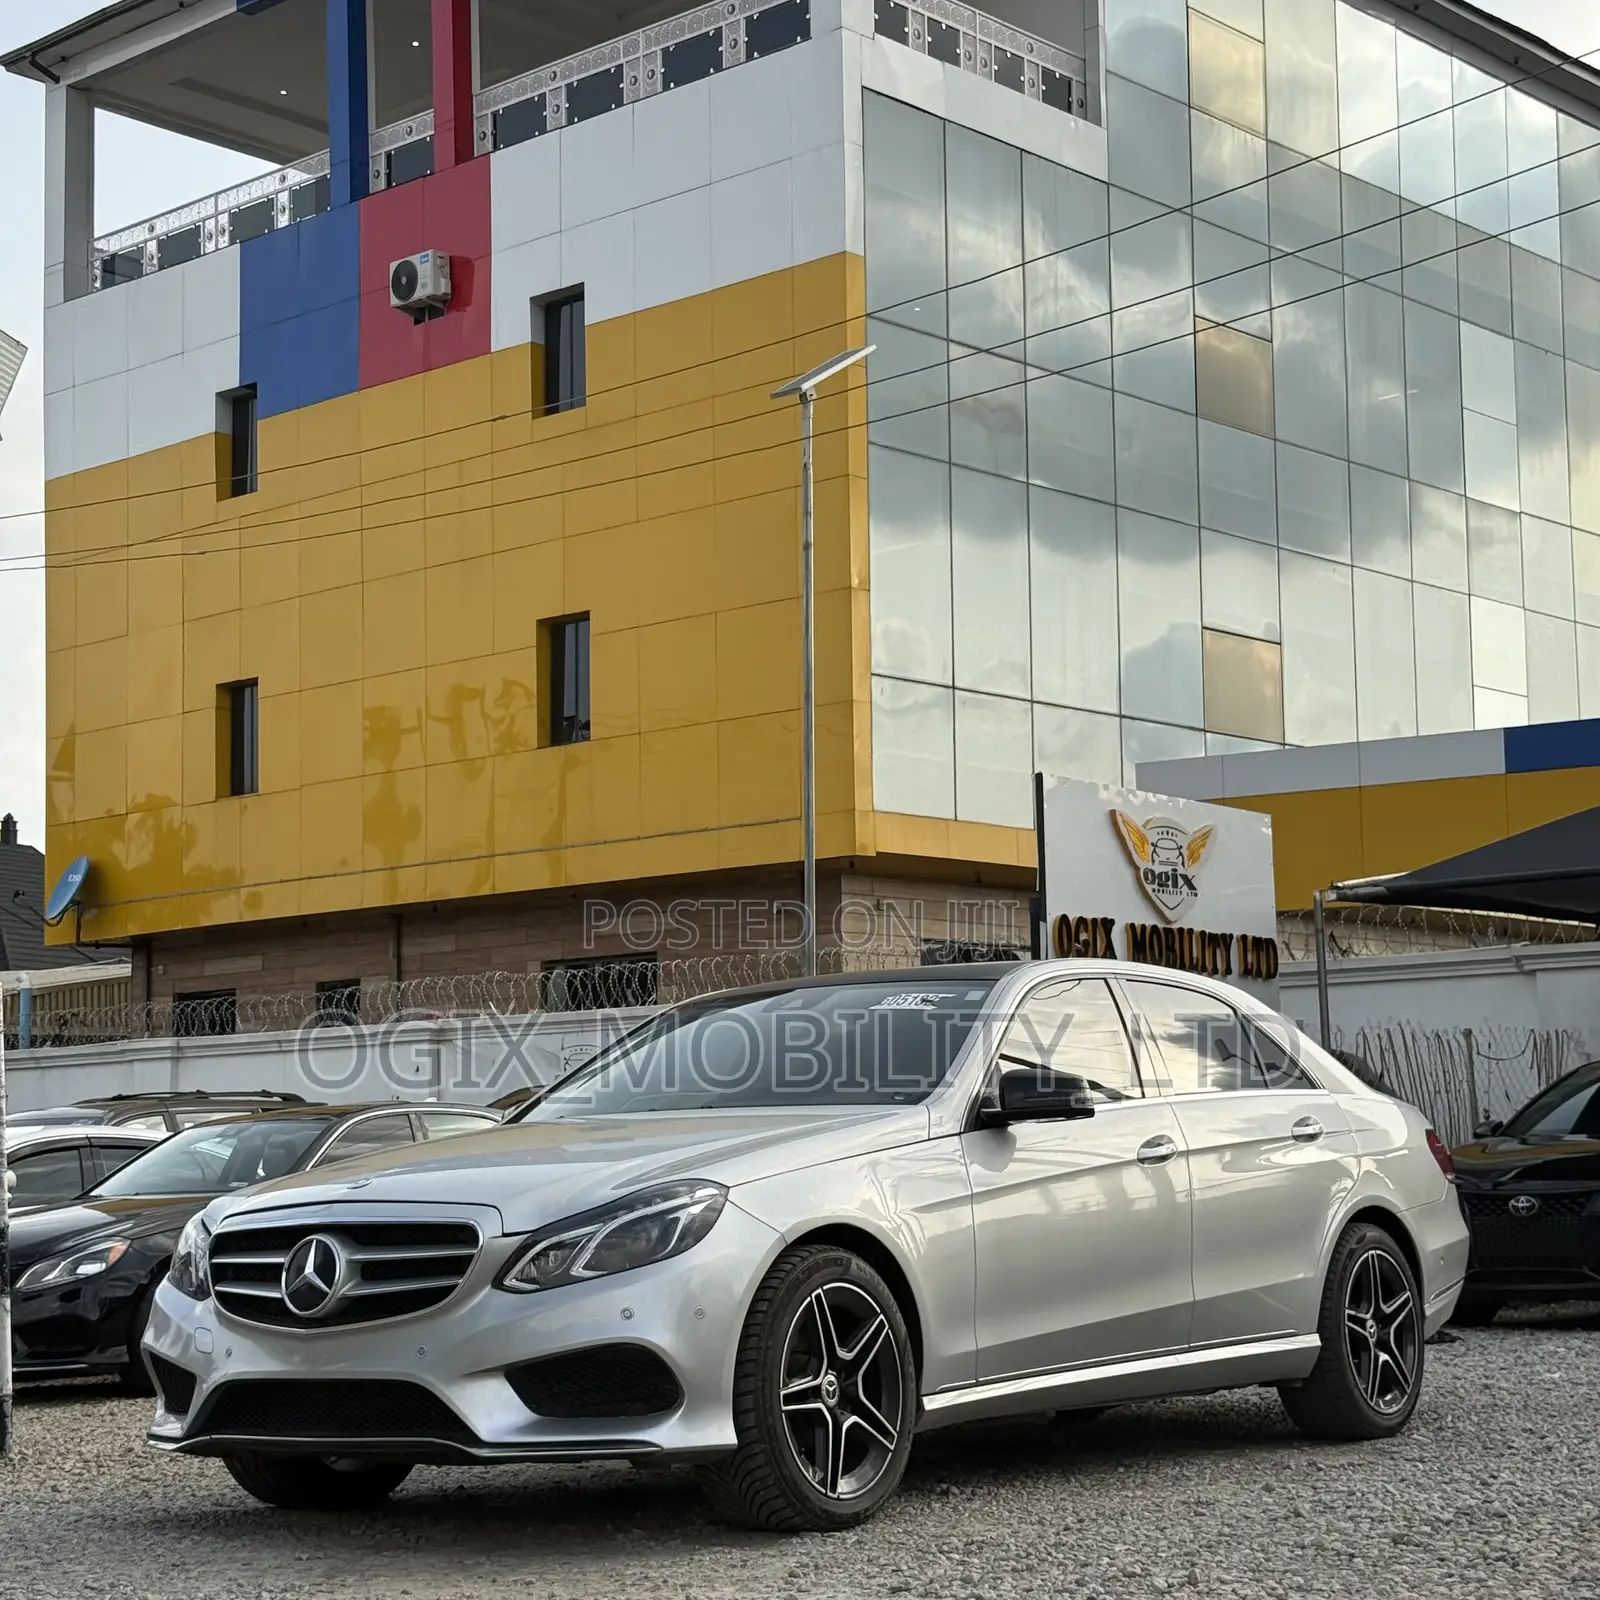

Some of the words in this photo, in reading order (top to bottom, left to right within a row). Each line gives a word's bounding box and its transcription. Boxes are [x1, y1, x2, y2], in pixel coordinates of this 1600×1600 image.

[1053, 913, 1117, 959] OGIX
[1124, 922, 1234, 978] MOBILITY
[1236, 933, 1279, 980] LTD
